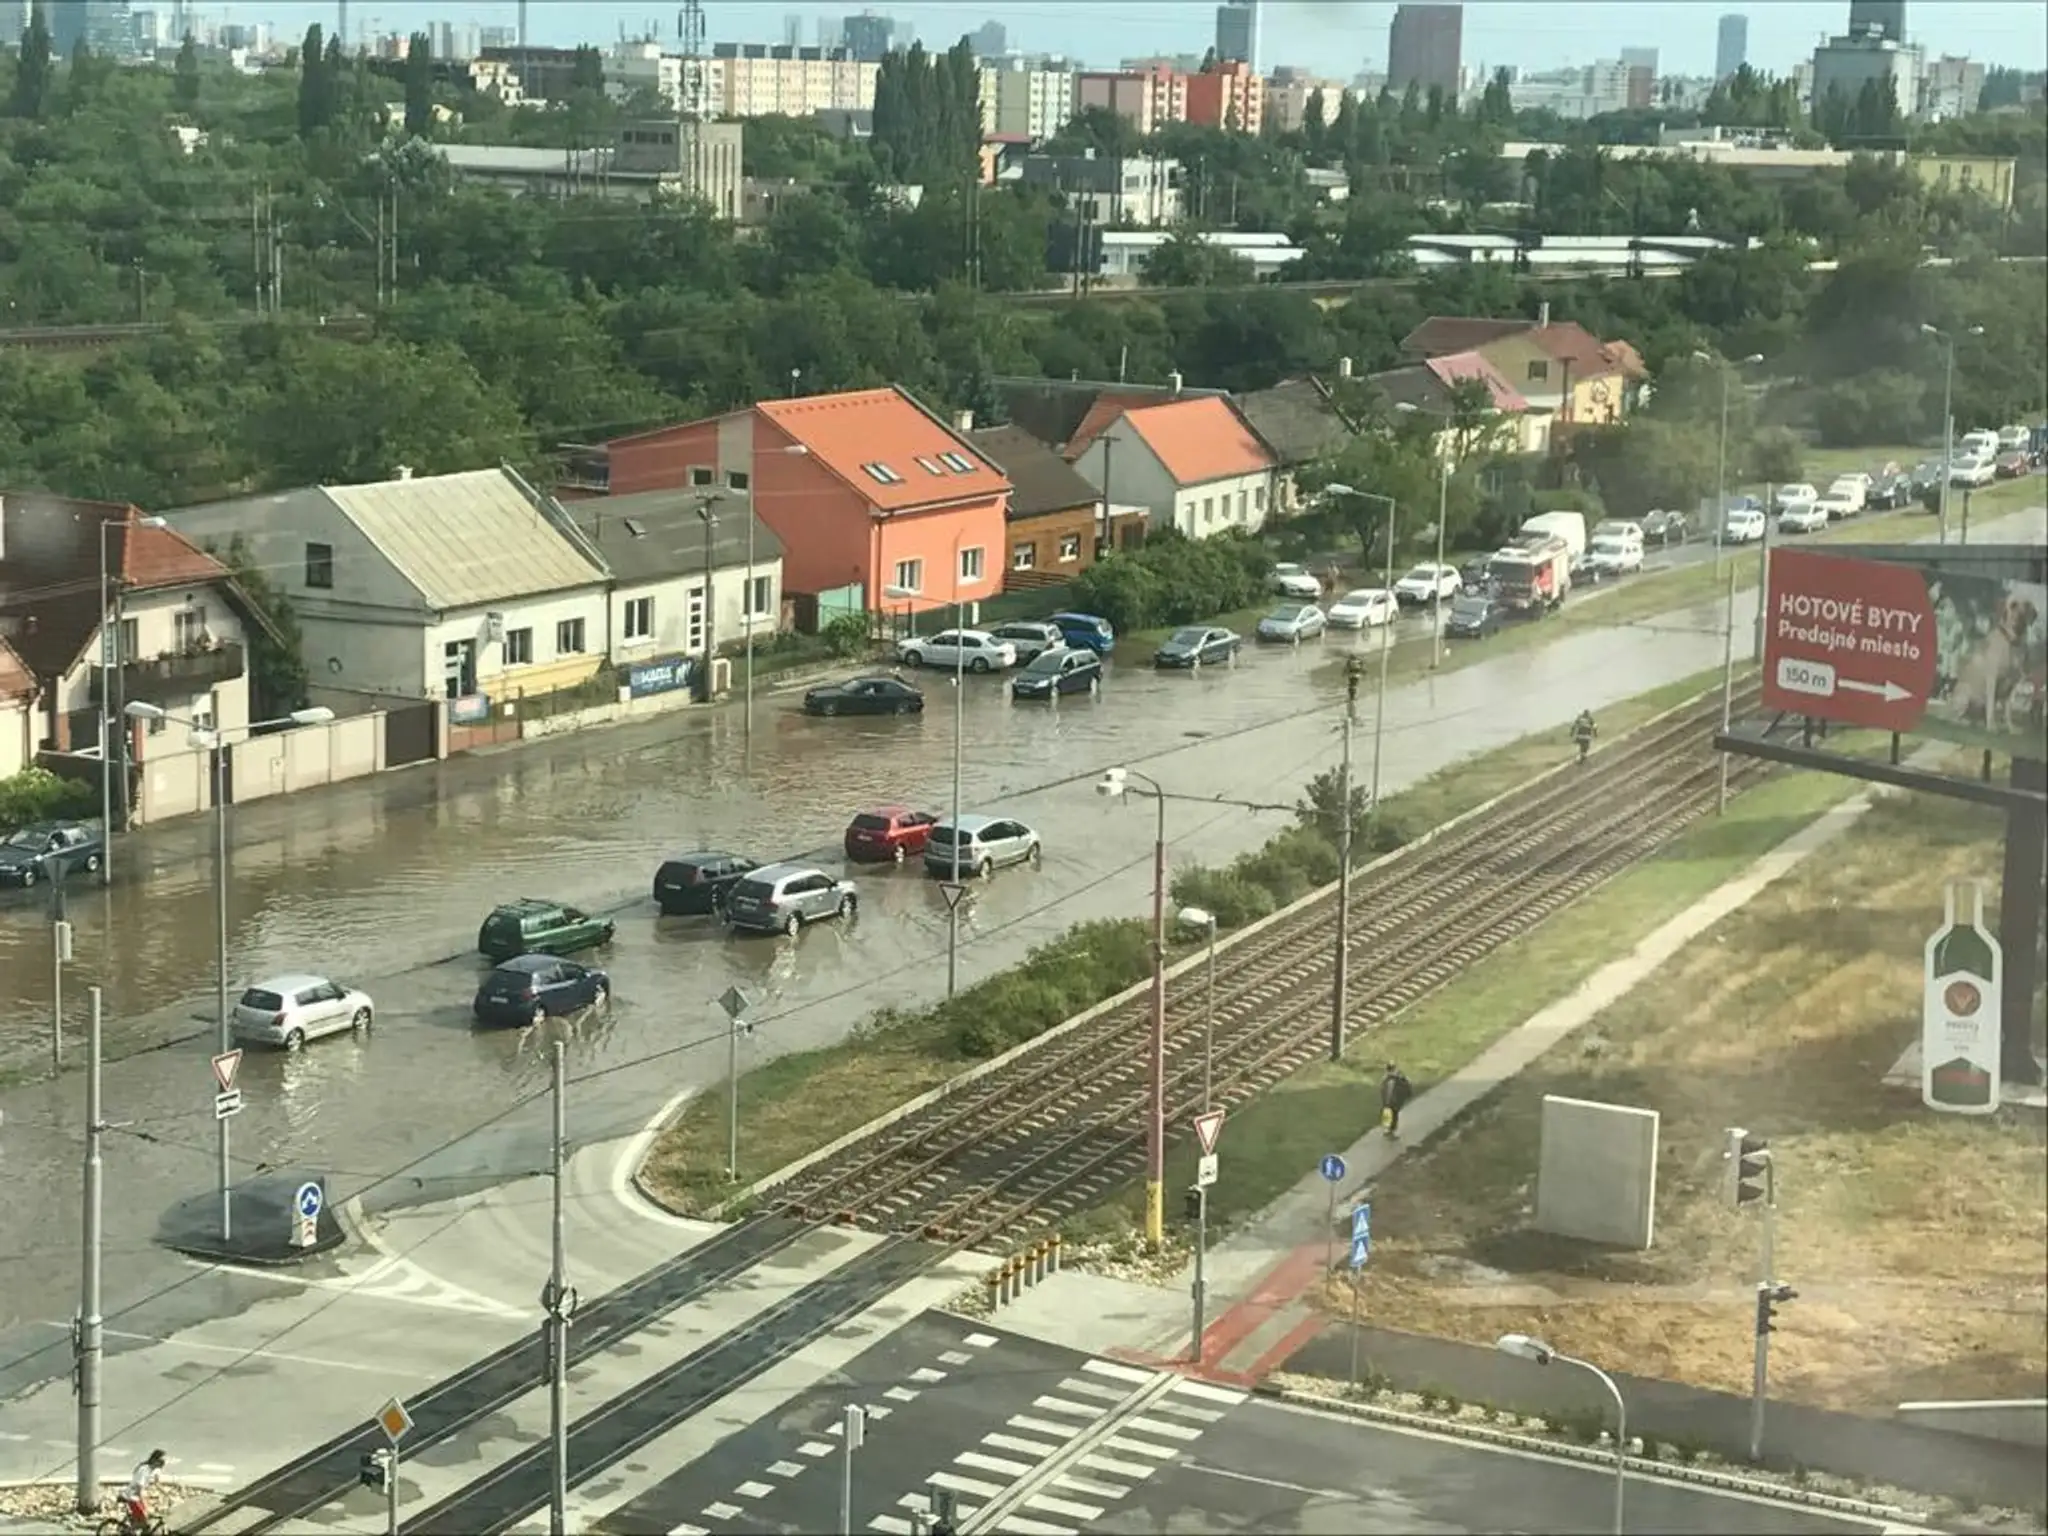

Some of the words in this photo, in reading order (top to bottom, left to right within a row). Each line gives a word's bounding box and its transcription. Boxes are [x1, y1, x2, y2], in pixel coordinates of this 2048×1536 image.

[1780, 592, 1863, 625] HOTOVÉ
[1867, 606, 1922, 633] BYTY
[1778, 619, 1857, 652] Predajné
[1860, 634, 1920, 660] miesto
[1786, 667, 1809, 684] 150
[1811, 674, 1827, 688] m
